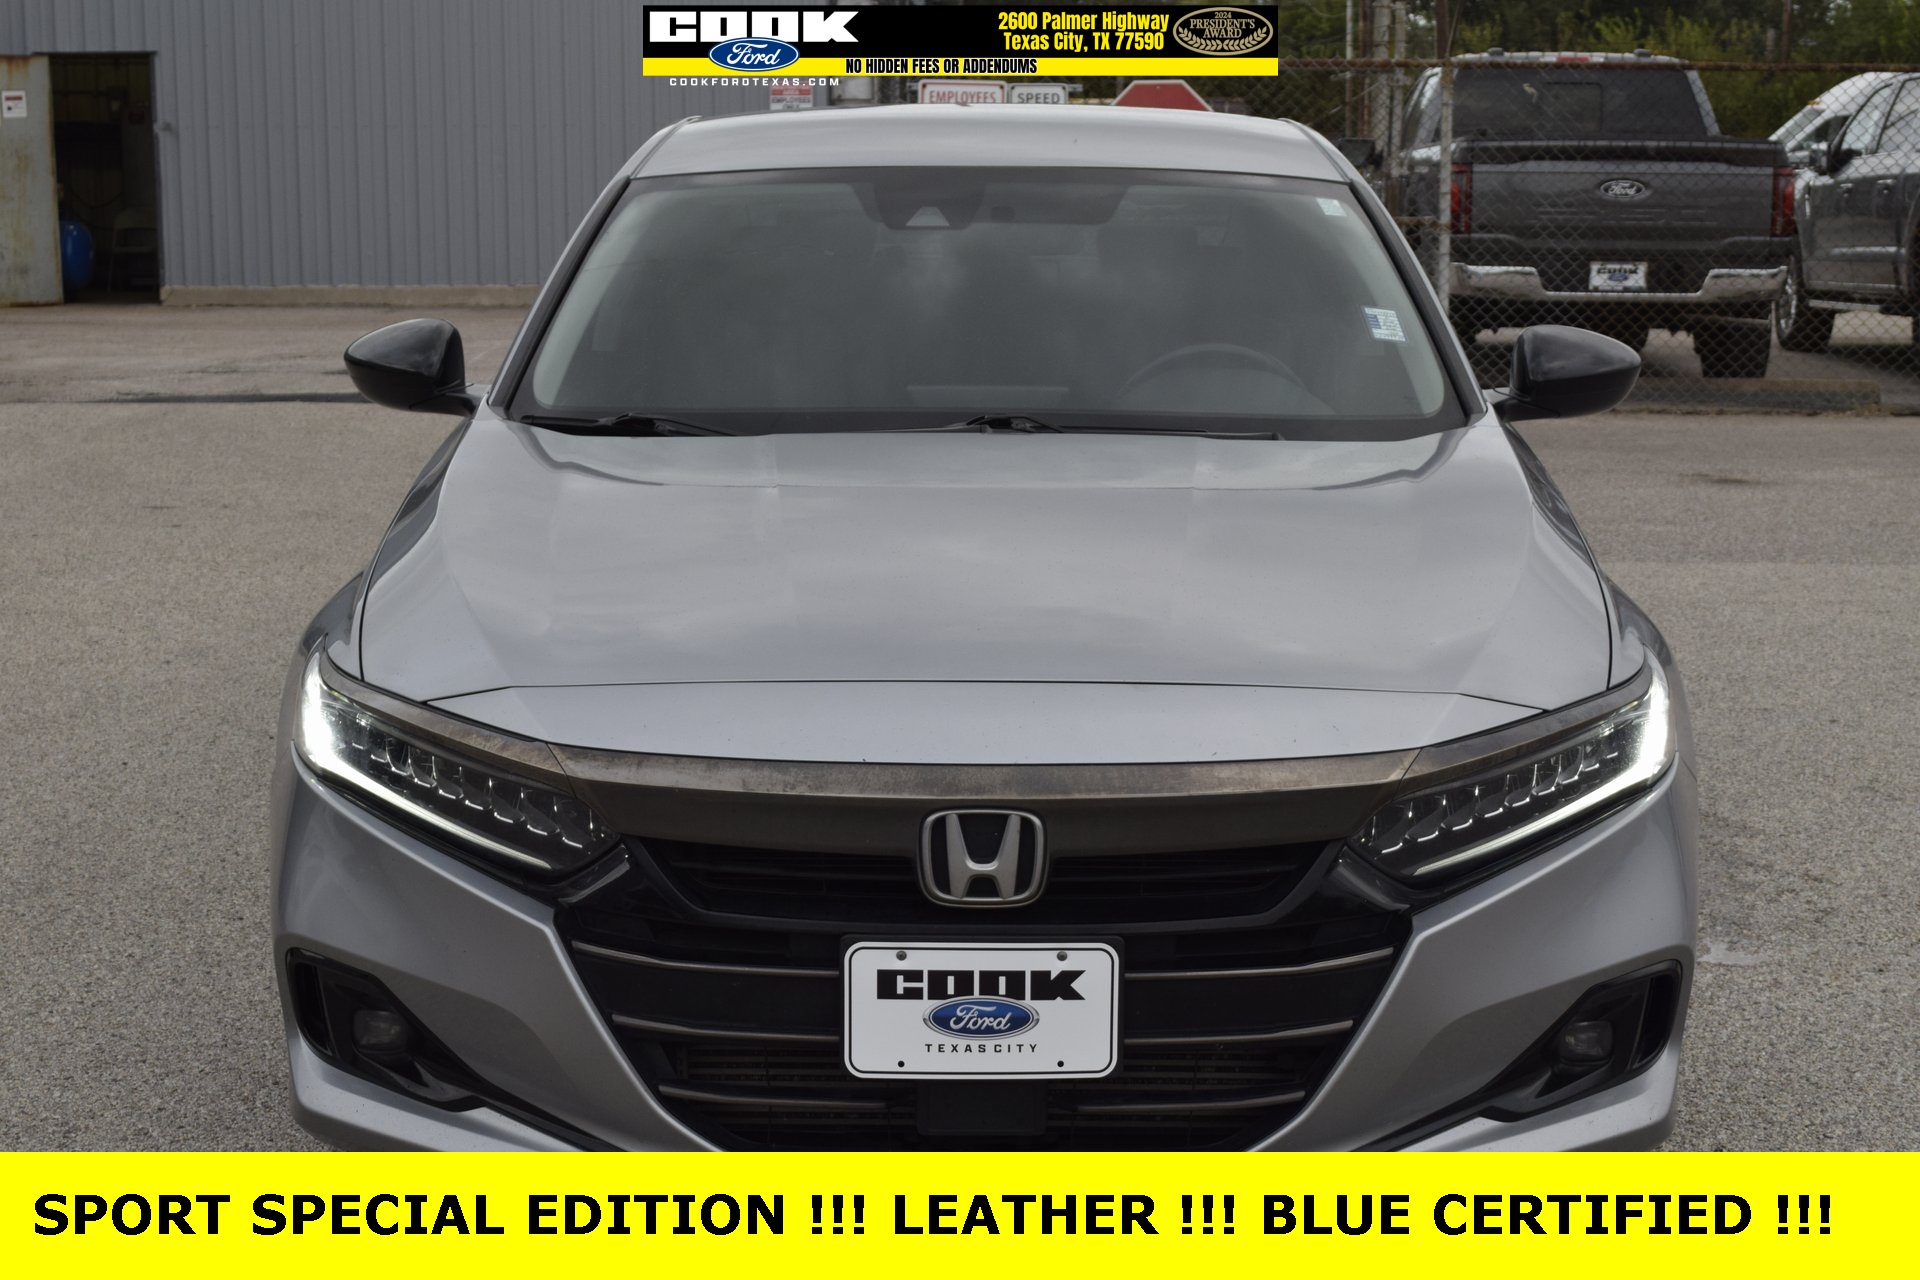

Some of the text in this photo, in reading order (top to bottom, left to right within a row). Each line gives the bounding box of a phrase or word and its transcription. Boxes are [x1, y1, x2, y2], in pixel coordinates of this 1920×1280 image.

[928, 90, 997, 104] EMPLOYEES
[1017, 92, 1060, 104] SPEED
[877, 969, 1086, 1001] COOK
[949, 1004, 1012, 1030] Ford
